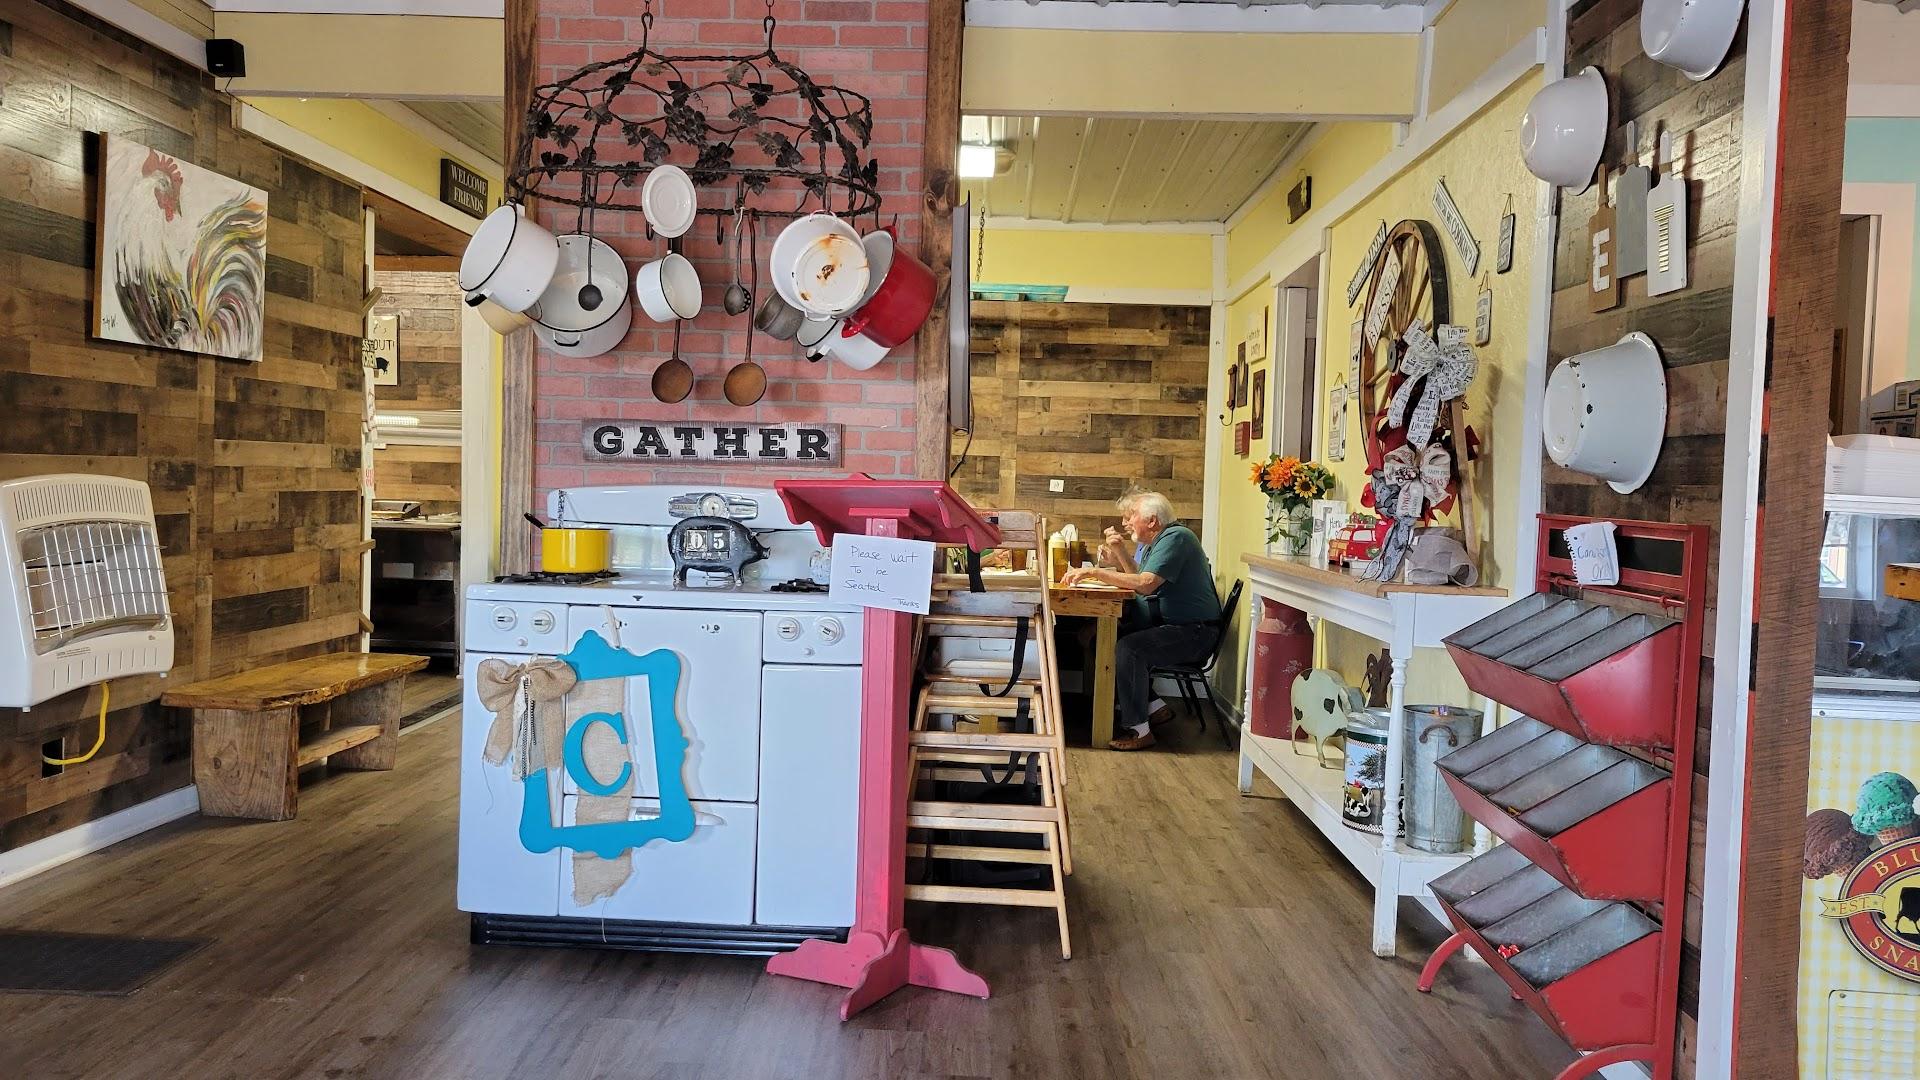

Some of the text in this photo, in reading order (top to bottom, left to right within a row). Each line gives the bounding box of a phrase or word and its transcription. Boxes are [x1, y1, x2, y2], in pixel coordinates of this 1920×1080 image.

[451, 164, 487, 197] WELCOME
[454, 186, 484, 214] FRIENDS
[1592, 203, 1675, 293] E T
[1367, 262, 1400, 349] BLESSED
[593, 425, 831, 460] GATHER
[849, 565, 862, 574] To
[850, 544, 882, 561] Please
[843, 579, 885, 593] Seated
[562, 711, 632, 796] C
[1869, 935, 1920, 971] SNA
